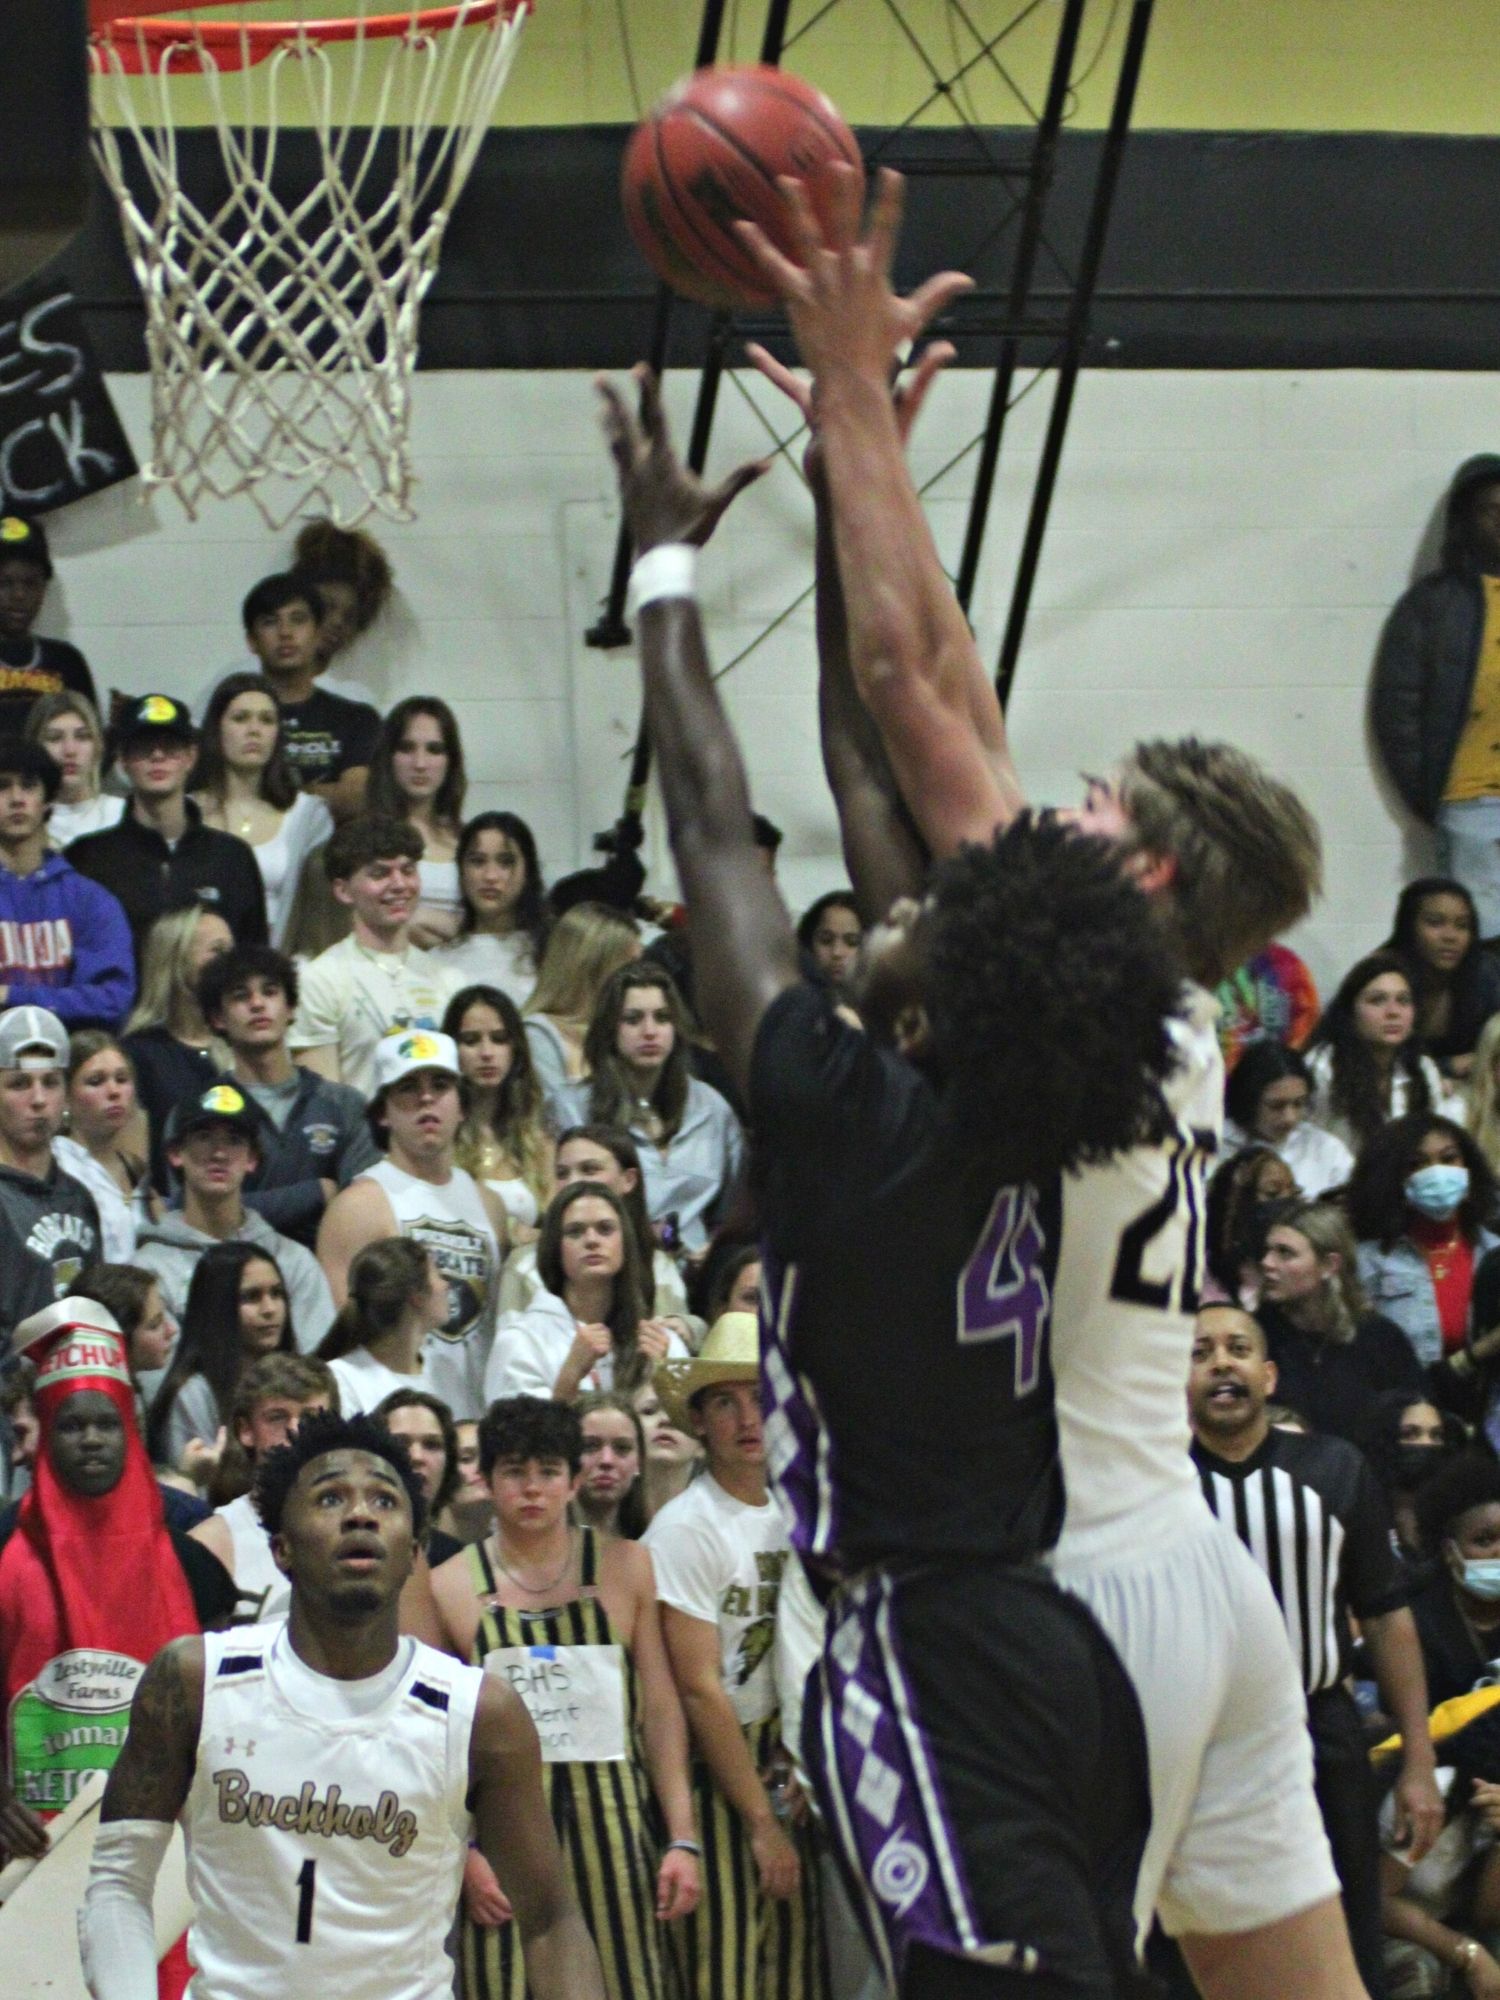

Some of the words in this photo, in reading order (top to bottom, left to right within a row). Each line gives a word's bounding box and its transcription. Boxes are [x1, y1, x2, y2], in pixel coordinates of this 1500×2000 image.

[956, 1182, 1050, 1398] 4
[68, 1682, 121, 1699] Farms
[505, 1663, 572, 1694] BHS
[212, 1768, 418, 1857] Buchholz
[295, 1859, 316, 1944] 1
